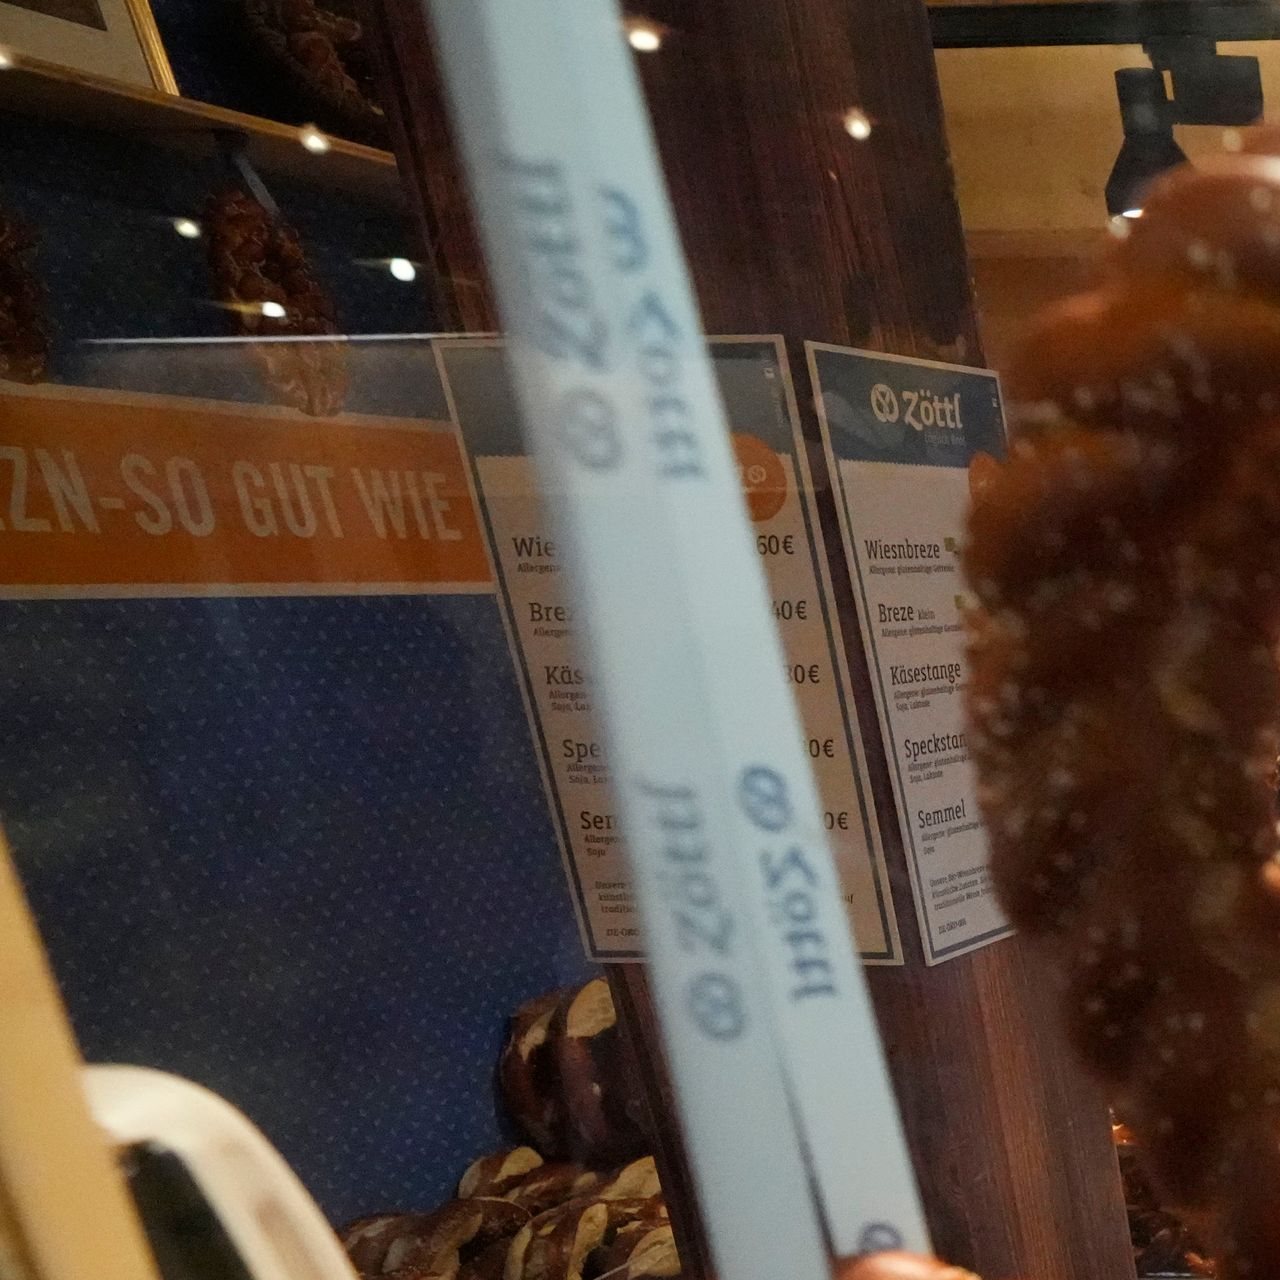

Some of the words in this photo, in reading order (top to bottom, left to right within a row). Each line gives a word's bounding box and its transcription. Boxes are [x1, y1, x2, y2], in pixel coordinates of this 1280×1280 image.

[902, 388, 963, 432] Zöttl
[0, 446, 217, 538] ZN-SO
[232, 459, 345, 539] GUT
[351, 467, 464, 541] WIE
[512, 536, 556, 557] Wie
[756, 534, 795, 555] 60€
[864, 538, 940, 559] Wiesnbreze
[528, 602, 571, 622] Bre
[878, 603, 914, 623] Breze
[544, 665, 585, 686] Käs
[890, 663, 961, 686] Käsestange
[562, 739, 606, 763] Spe
[904, 733, 968, 761] Speckstan
[918, 798, 967, 829] Semmel
[758, 846, 839, 1002] Zöttl
